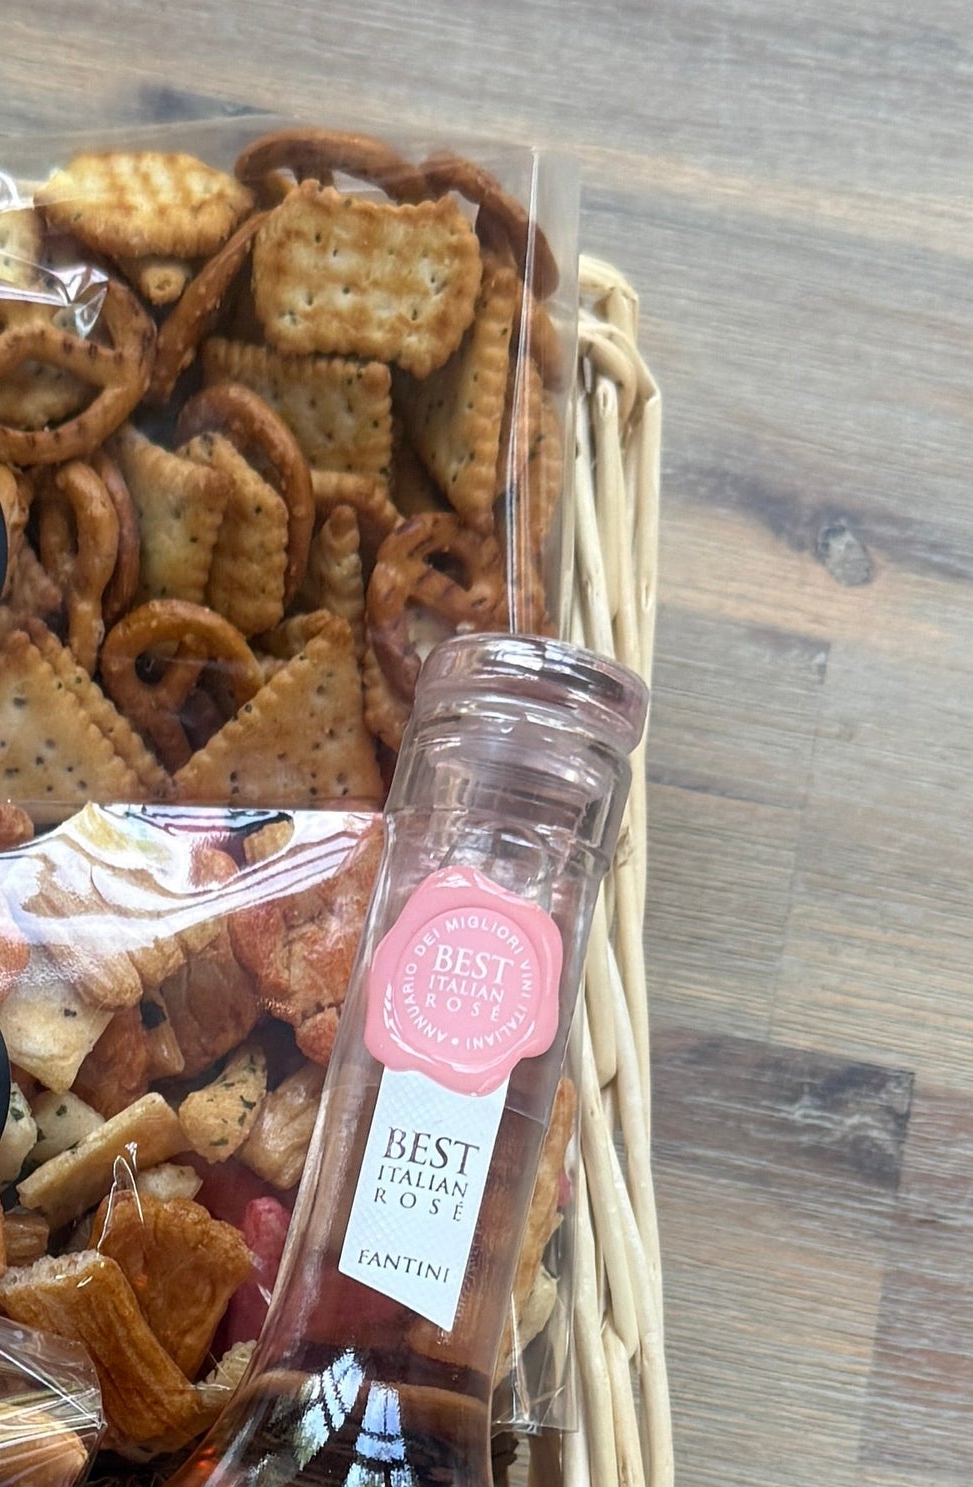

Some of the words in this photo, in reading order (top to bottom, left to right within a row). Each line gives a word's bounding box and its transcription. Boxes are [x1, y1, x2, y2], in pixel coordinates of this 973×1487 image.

[414, 928, 440, 957] DEI
[445, 915, 525, 955] MIGLIORI
[432, 944, 515, 985] BEST
[520, 959, 532, 999] VINI
[402, 962, 448, 1043] ANNUARIO
[425, 993, 501, 1022] ROSÉ
[429, 974, 505, 1004] ITALIAN
[466, 1004, 528, 1050] ITALIANI
[383, 1126, 480, 1176] BEST
[377, 1165, 468, 1198] ITALIAN
[374, 1187, 464, 1222] ROSÉ
[358, 1249, 450, 1283] FANTINI
